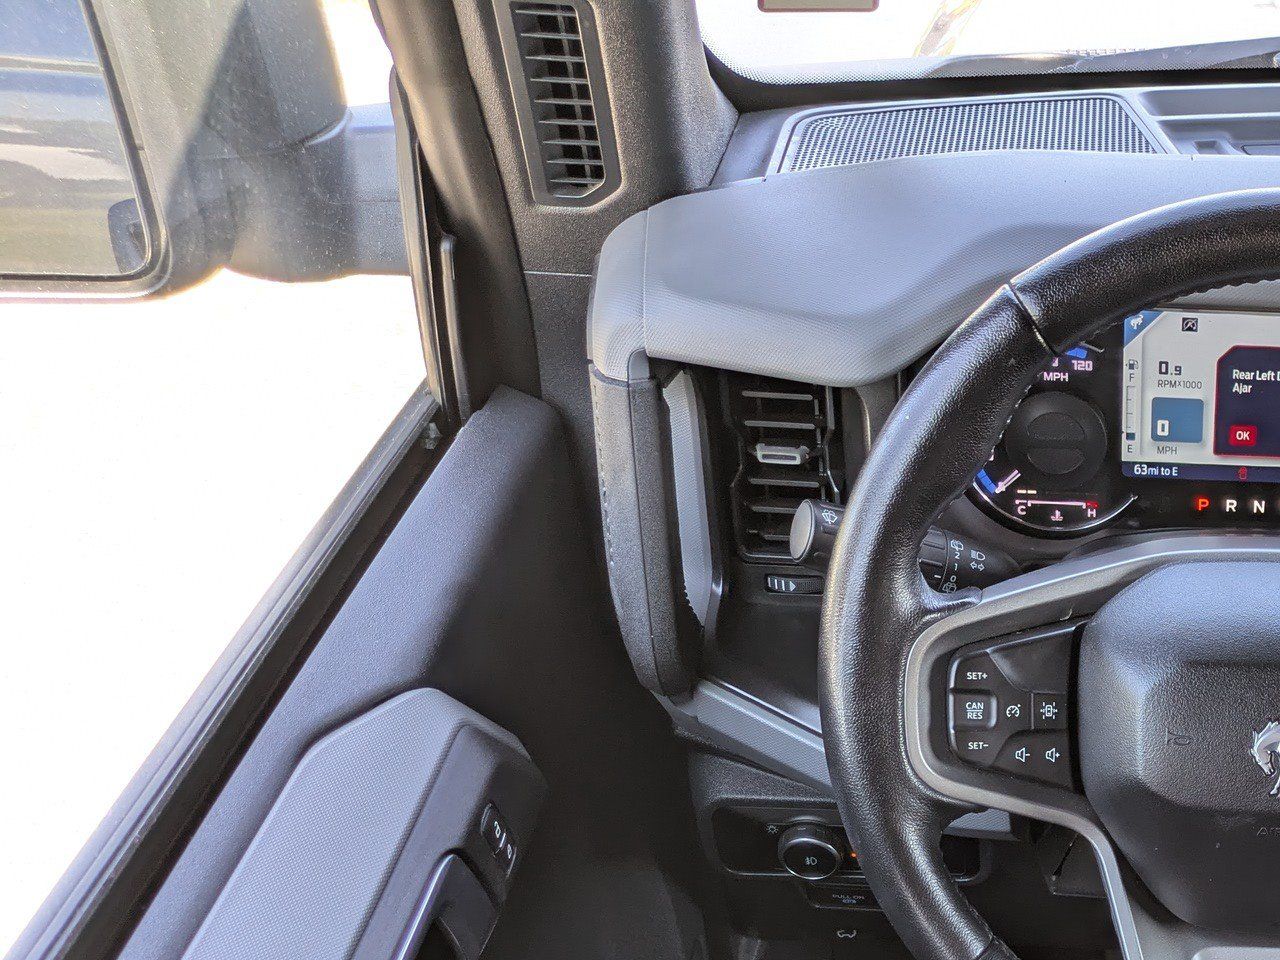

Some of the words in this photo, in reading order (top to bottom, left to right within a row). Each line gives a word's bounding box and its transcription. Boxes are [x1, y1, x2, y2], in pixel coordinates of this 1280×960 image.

[1071, 360, 1094, 372] 120
[1158, 360, 1183, 376] 0.9
[1043, 371, 1069, 383] MPH
[1129, 373, 1135, 382] F
[1232, 370, 1255, 382] Rear
[1256, 370, 1276, 383] Left
[1232, 382, 1252, 395] Ajar
[1156, 419, 1170, 437] 0
[1235, 431, 1250, 442] OK
[1127, 445, 1133, 453] E
[1156, 446, 1178, 455] MPH
[1134, 463, 1159, 475] 63mi
[1161, 465, 1170, 475] to
[1172, 466, 1178, 476] E
[1017, 505, 1027, 516] C
[1198, 498, 1209, 511] P
[1225, 499, 1237, 514] R
[1253, 501, 1265, 514] N
[1087, 508, 1097, 518] H
[950, 575, 957, 583] 0
[966, 671, 988, 680] SET+
[965, 702, 984, 710] CAN
[966, 711, 983, 720] RES
